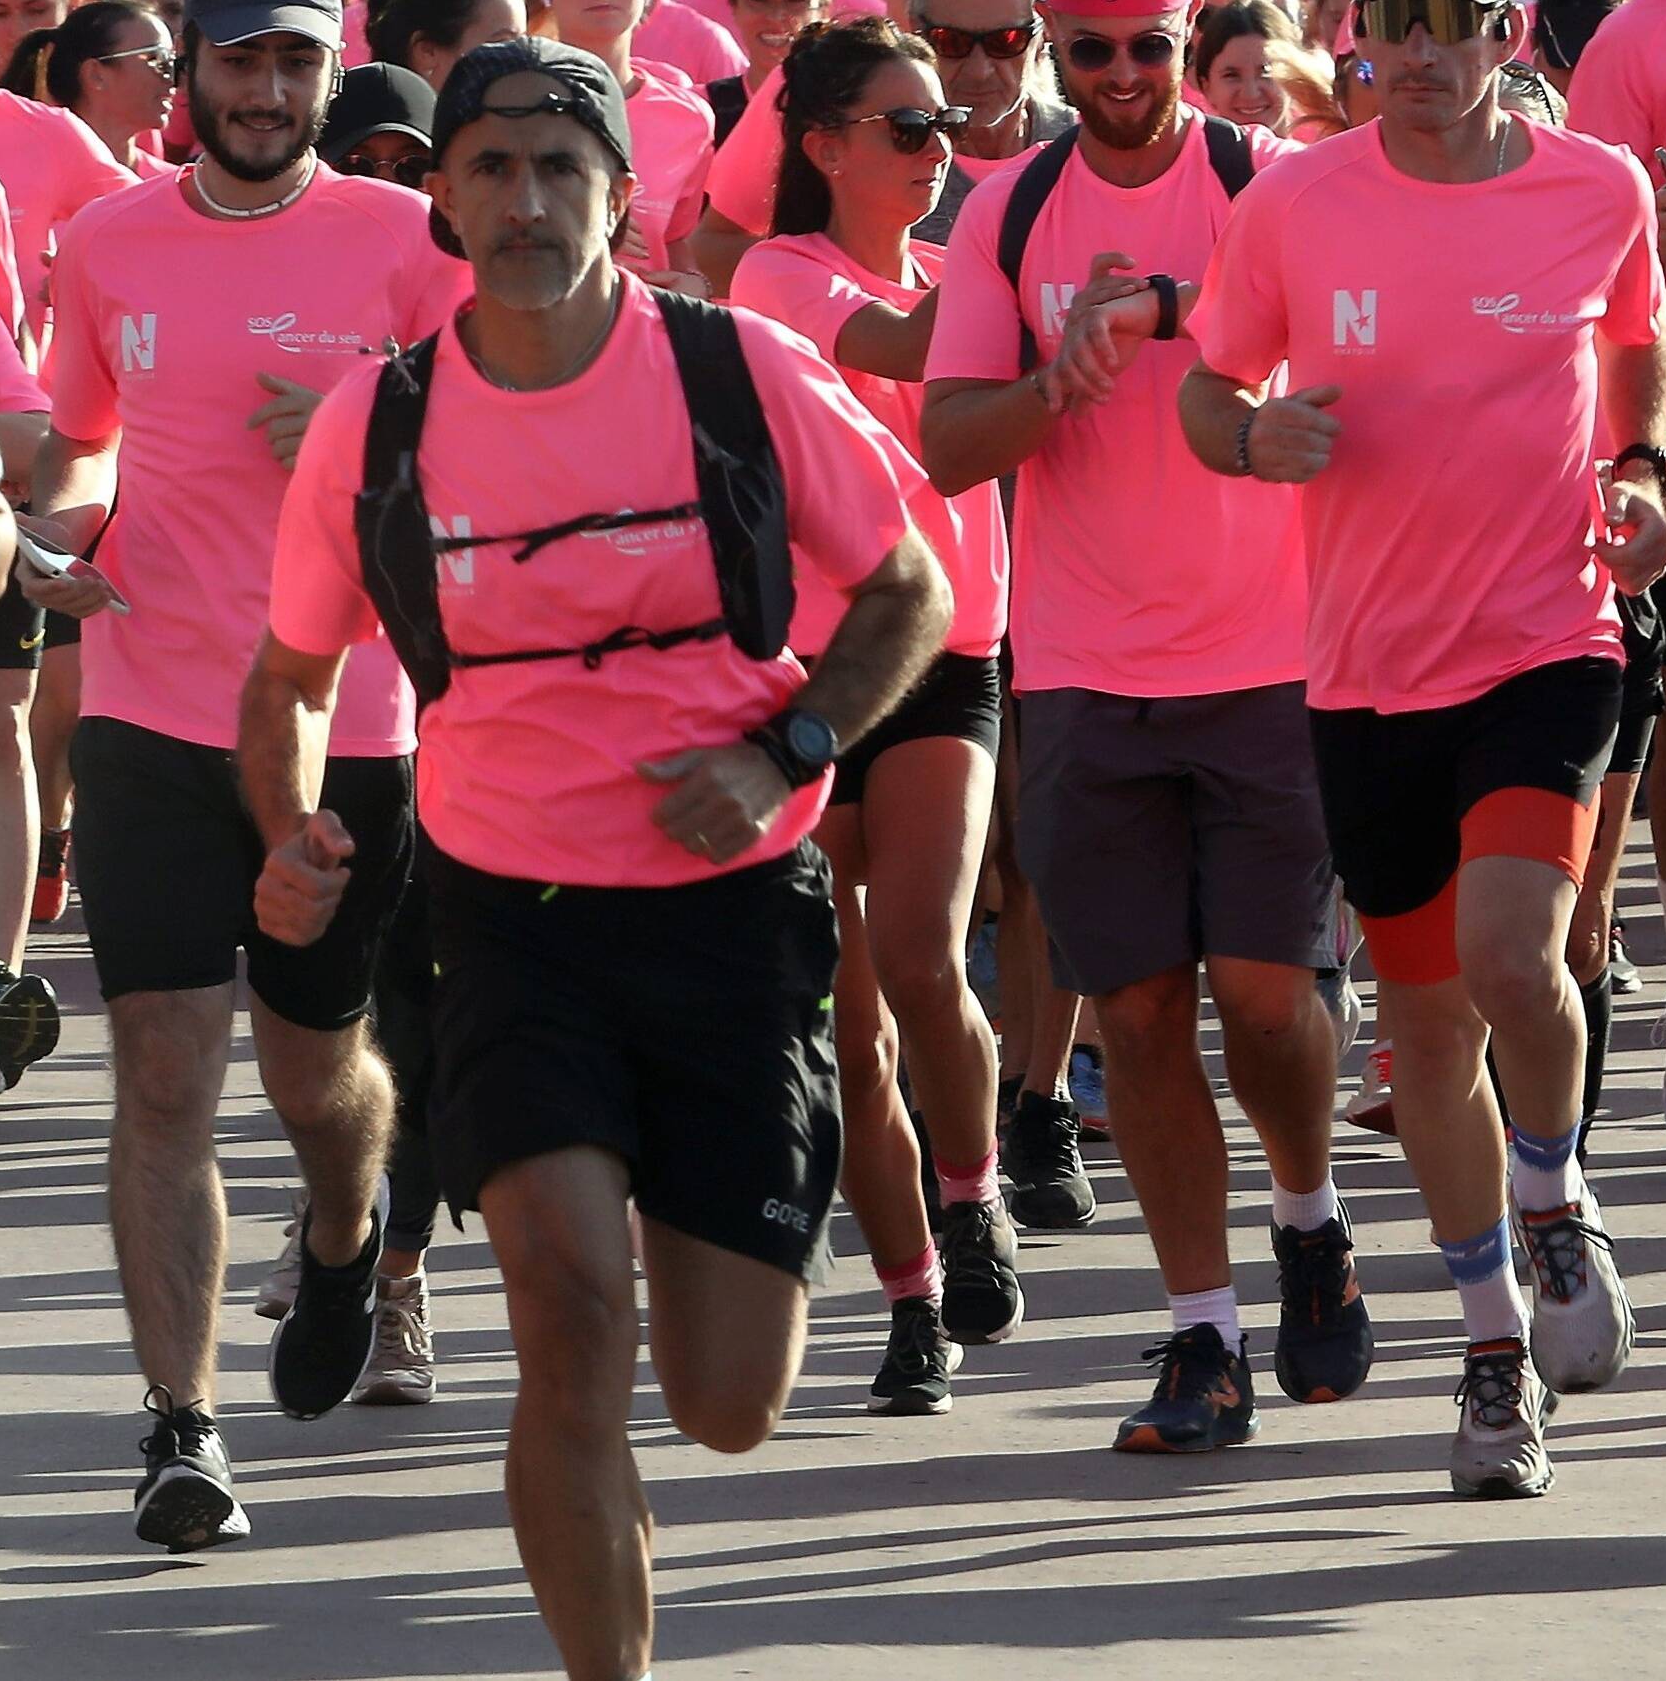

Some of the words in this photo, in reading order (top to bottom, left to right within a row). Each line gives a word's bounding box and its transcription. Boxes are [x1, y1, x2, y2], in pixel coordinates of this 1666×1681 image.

[247, 317, 273, 329] SOS
[1334, 289, 1377, 346] N
[121, 313, 157, 372] N
[318, 330, 334, 344] du
[337, 331, 362, 345] sein
[763, 1198, 808, 1233] GORE
